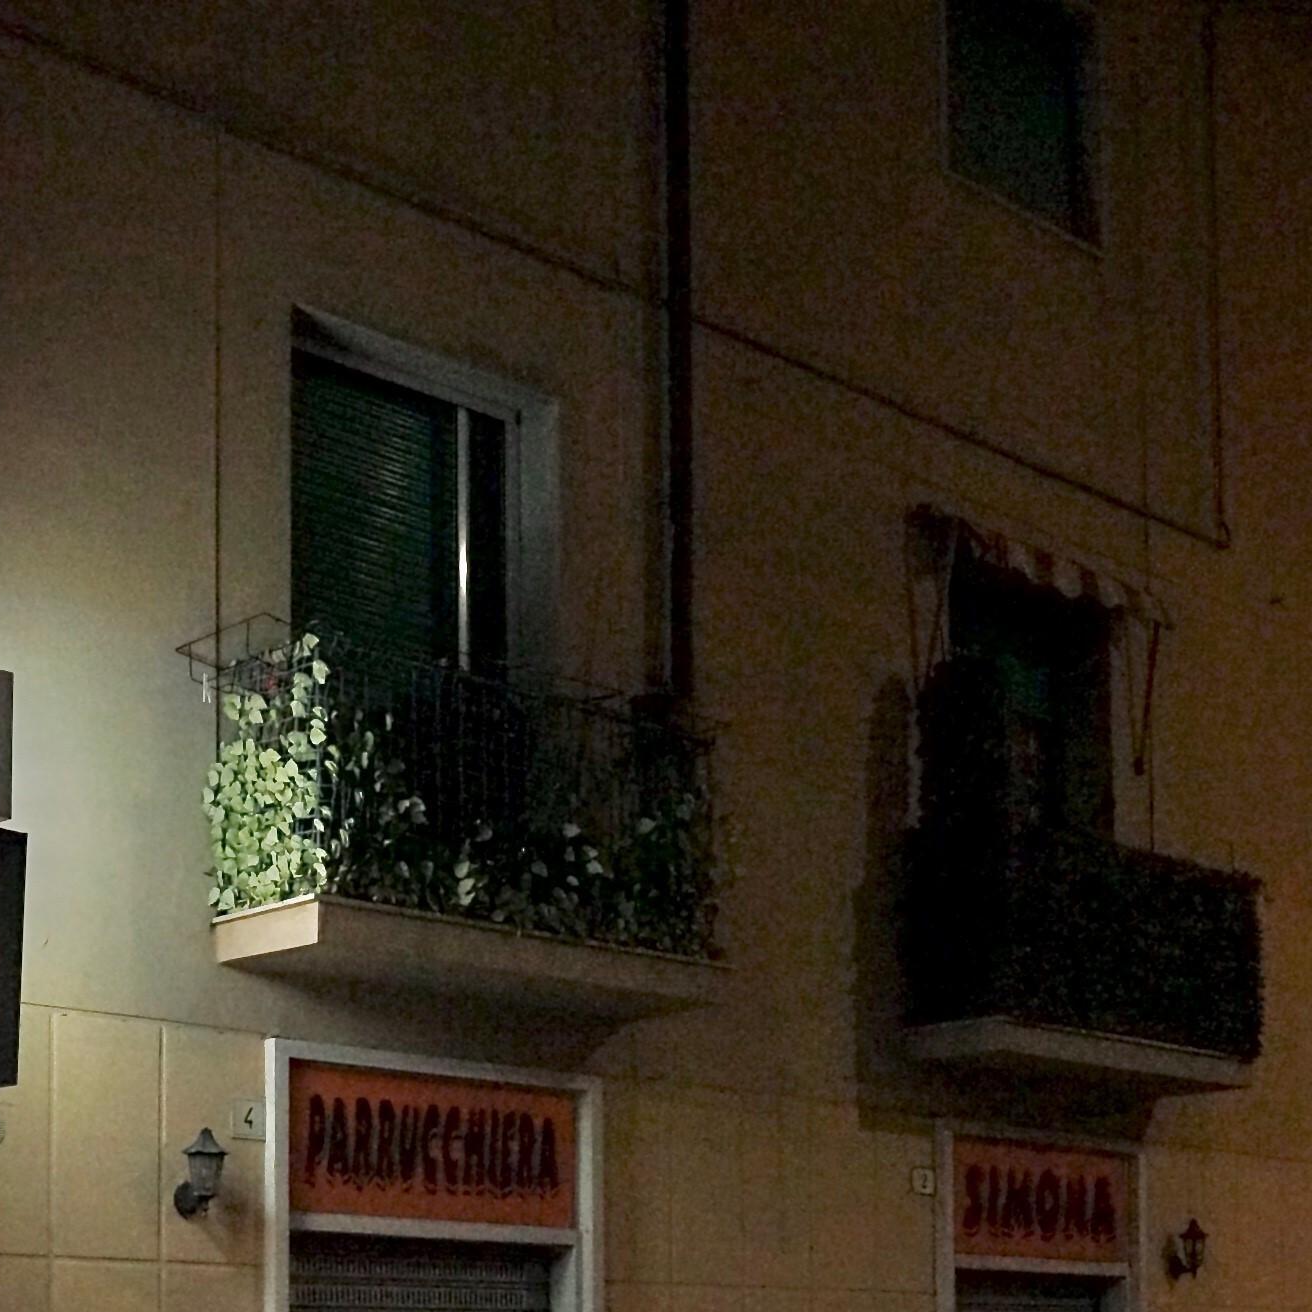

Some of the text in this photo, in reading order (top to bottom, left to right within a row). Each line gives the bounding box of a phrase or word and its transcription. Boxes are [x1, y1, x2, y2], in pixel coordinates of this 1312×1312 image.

[244, 1106, 254, 1130] 4
[304, 1093, 563, 1199] PARRUCCHIERA
[963, 1162, 1118, 1244] SIMONA
